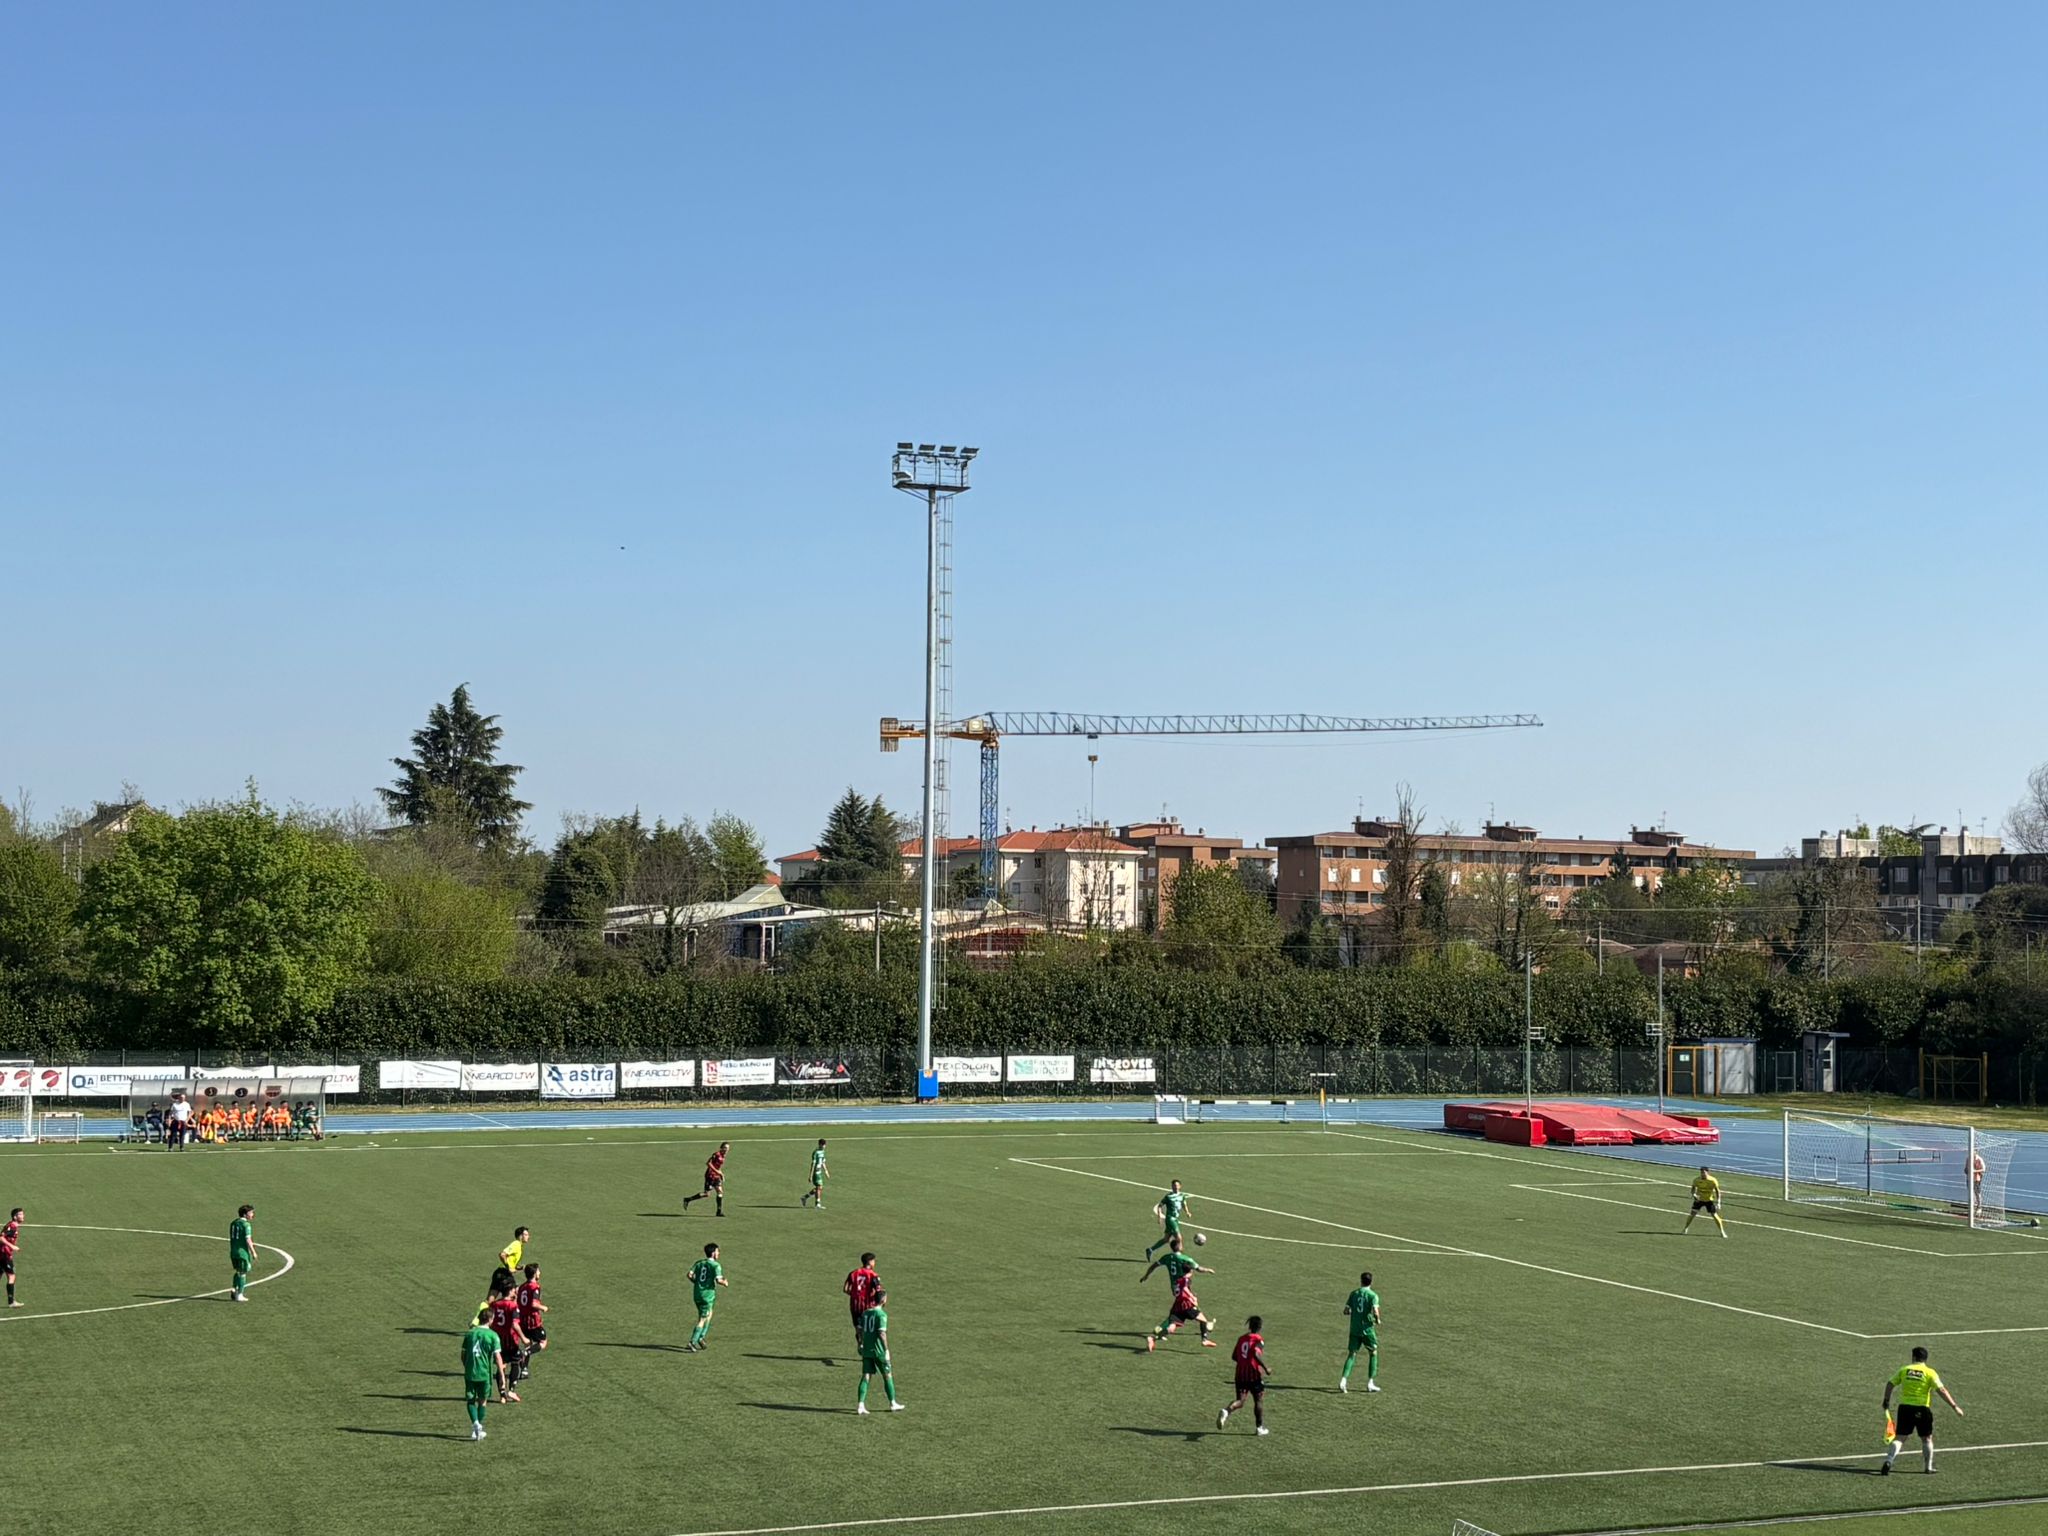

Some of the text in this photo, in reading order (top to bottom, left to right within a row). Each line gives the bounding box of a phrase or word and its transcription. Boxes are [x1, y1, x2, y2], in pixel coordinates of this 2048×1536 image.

[569, 1067, 614, 1082] astra
[700, 1266, 707, 1282] 8
[520, 1290, 528, 1305] 6
[1356, 1297, 1364, 1313] 3
[497, 1309, 505, 1326] 3
[863, 1315, 876, 1333] 10
[473, 1340, 481, 1357] 4
[1241, 1342, 1249, 1359] 9
